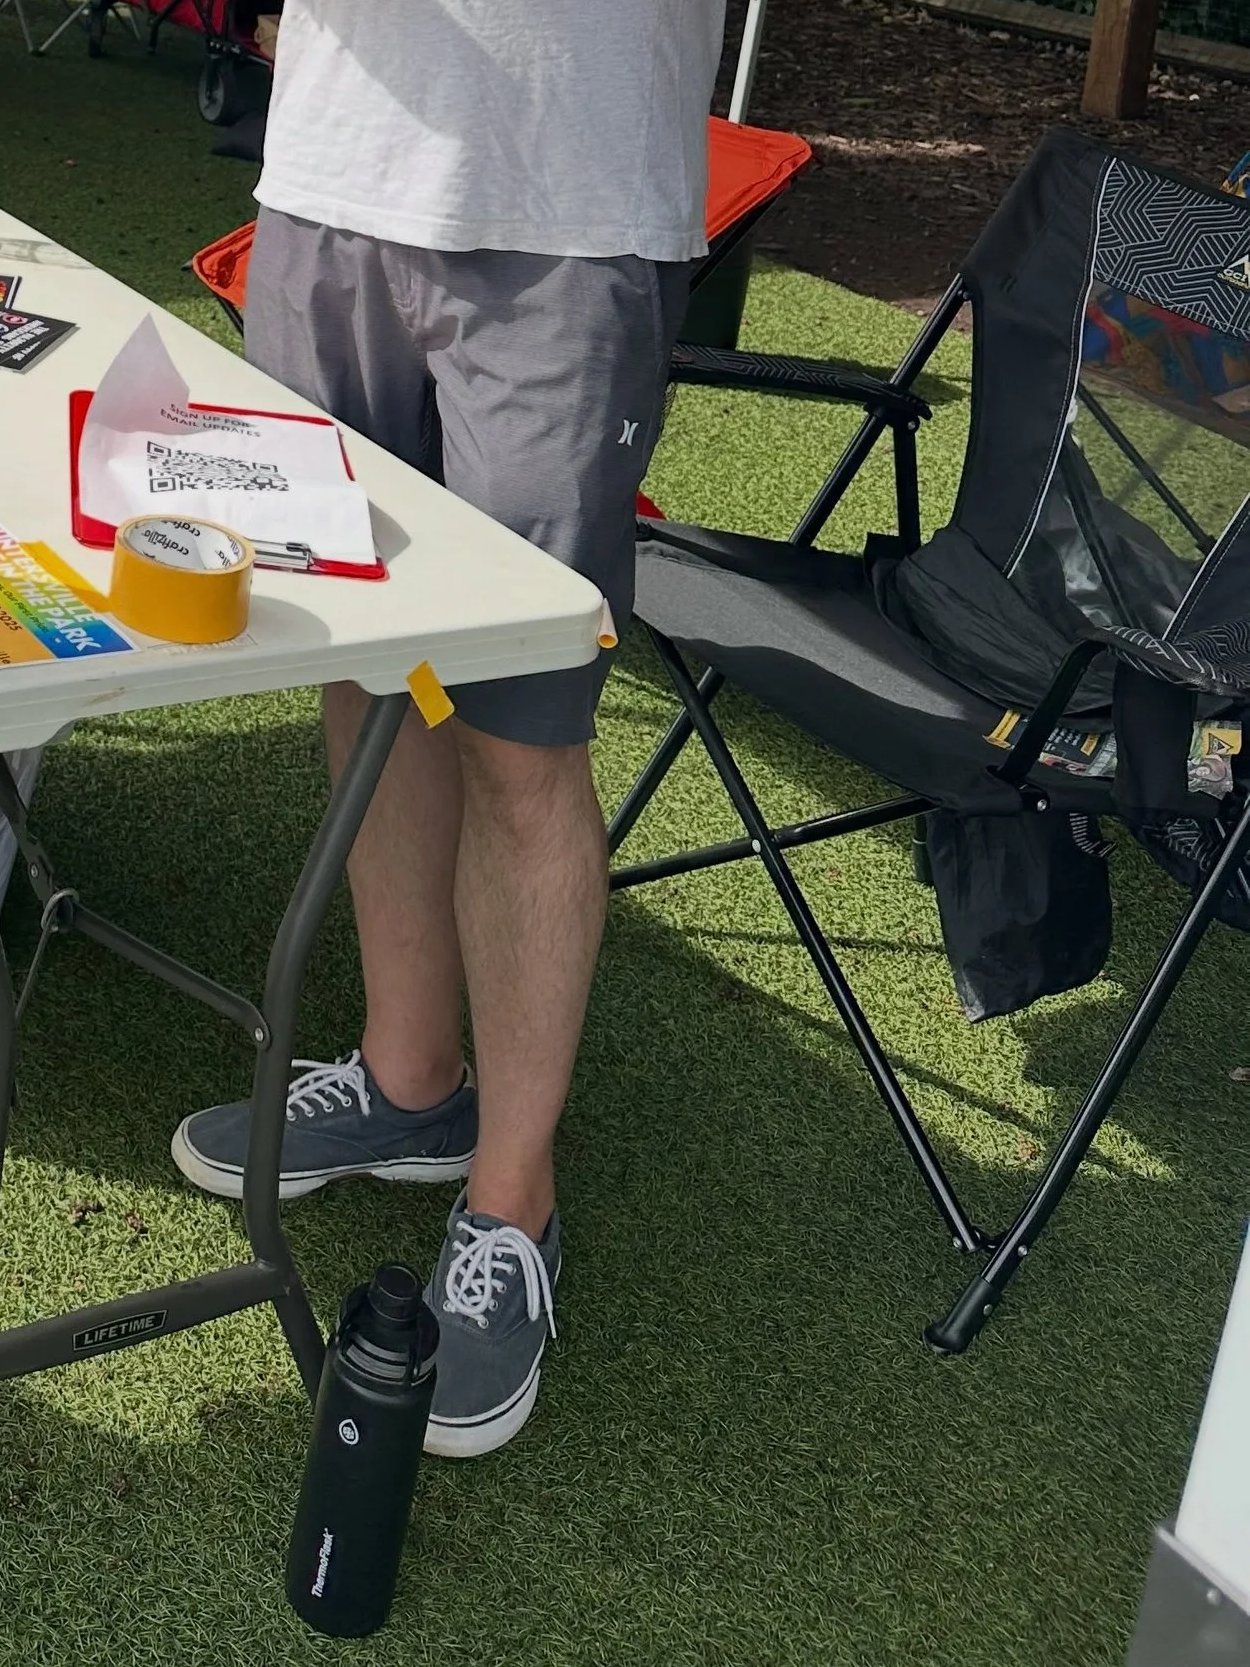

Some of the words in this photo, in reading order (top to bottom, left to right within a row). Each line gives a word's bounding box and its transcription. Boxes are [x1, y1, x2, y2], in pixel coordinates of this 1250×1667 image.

[160, 408, 200, 427] EMAIL
[202, 422, 262, 437] UPDATES
[170, 403, 199, 420] SIGN
[202, 414, 221, 422] UP
[224, 417, 252, 428] FOR
[13, 579, 51, 607] THE
[42, 605, 101, 651] PARK
[84, 1315, 156, 1345] LIFETIME
[311, 1528, 334, 1598] ThermoFlask
